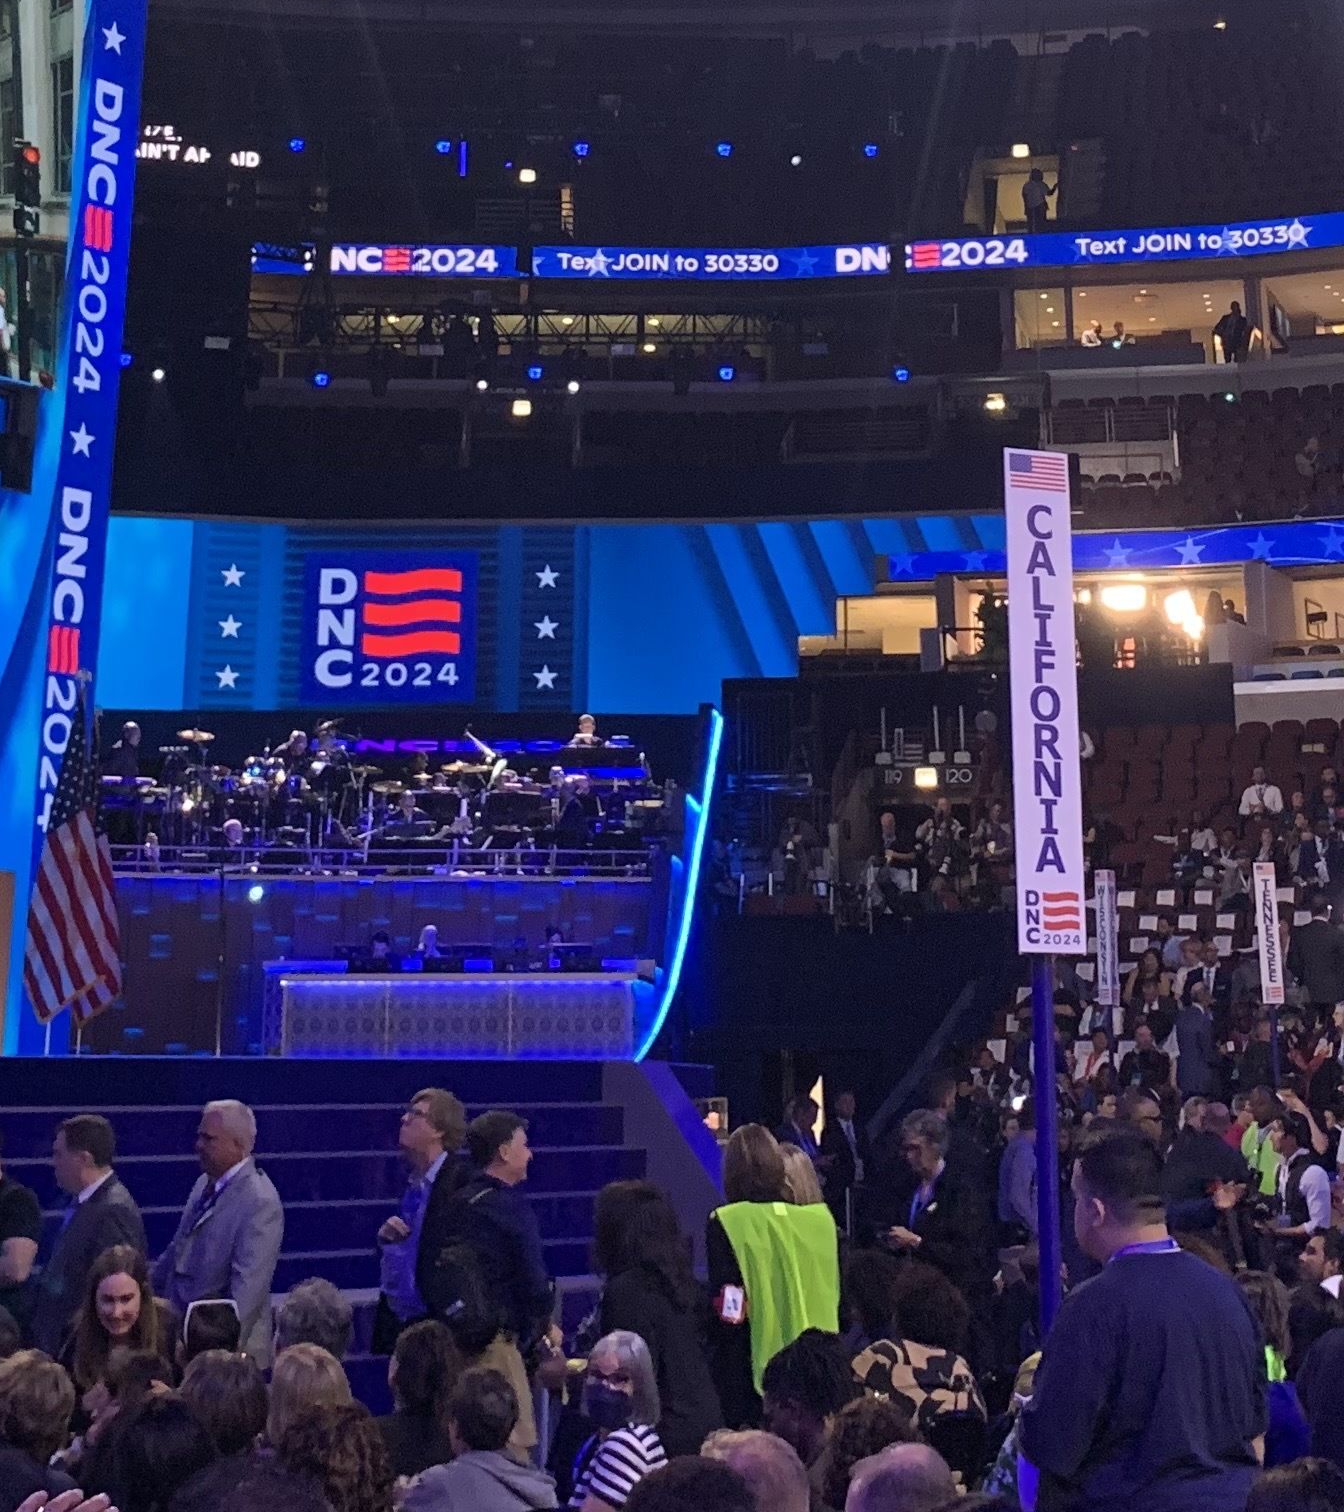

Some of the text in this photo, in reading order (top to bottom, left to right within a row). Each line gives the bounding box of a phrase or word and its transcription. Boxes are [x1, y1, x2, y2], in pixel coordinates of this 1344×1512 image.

[73, 77, 124, 393] DNC 2024
[330, 247, 383, 273] NC
[410, 247, 498, 273] 2024
[557, 252, 609, 272] Text
[611, 252, 669, 272] JOIN
[673, 253, 699, 272] to
[704, 253, 779, 273] 30330
[941, 239, 1029, 268] 2024
[1075, 237, 1125, 257] Text
[1132, 233, 1191, 254] JOIN
[1198, 232, 1223, 251] to
[1229, 222, 1306, 249] 30330
[53, 486, 93, 625] DNC
[314, 568, 359, 687] DNC
[360, 662, 460, 687] 2024
[1026, 504, 1066, 874] CALIFORNIA
[945, 768, 973, 784] 120
[1025, 890, 1040, 944] DNC
[1043, 934, 1081, 945] 2024
[1261, 878, 1277, 983] TENNESSEE
